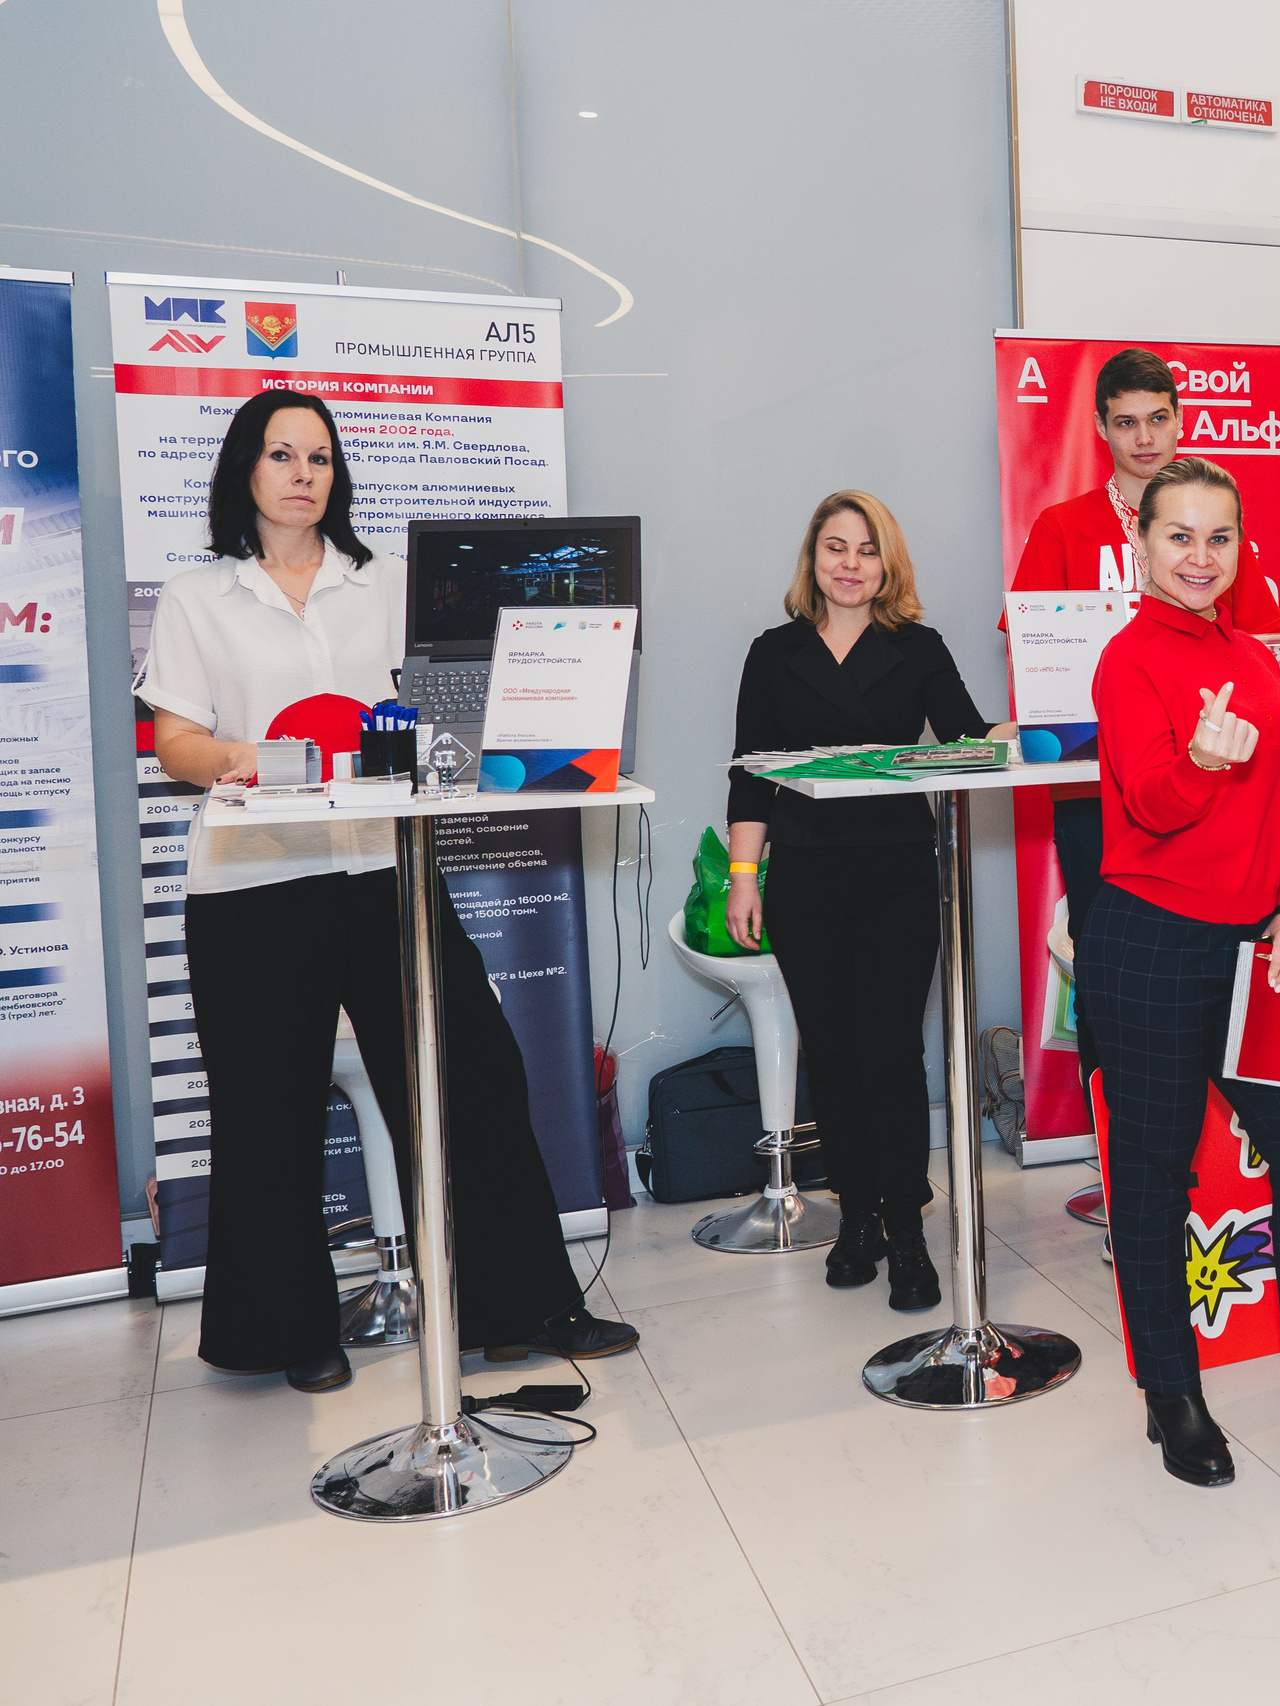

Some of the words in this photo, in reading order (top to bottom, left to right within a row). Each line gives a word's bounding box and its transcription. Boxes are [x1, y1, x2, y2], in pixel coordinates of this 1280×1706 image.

[1100, 83, 1158, 102] ПОРОШОК
[1100, 96, 1116, 108] НЕ
[1118, 98, 1157, 114] ВХОДИ
[1190, 94, 1267, 112] АВТОМАТИКА
[1193, 106, 1265, 124] ОТКЛЮЧЕНА
[485, 321, 536, 344] АЛ5
[335, 341, 475, 361] ПРОМЫШЛЕННАЯ
[480, 349, 537, 364] ГРУППА
[1166, 360, 1250, 393] Свой
[262, 378, 339, 392] ИСТОРИЯ
[342, 381, 434, 396] КОМПАНИИ
[332, 410, 422, 422] люминиевая
[425, 412, 492, 424] Компания
[340, 425, 375, 435] июня
[379, 425, 417, 435] 2002
[420, 428, 455, 437] года,
[159, 436, 177, 444] на
[180, 436, 224, 447] терри
[340, 439, 394, 450] абрики
[398, 440, 419, 449] им.
[422, 441, 450, 450] Я.М.
[453, 440, 530, 453] Свердлова,
[0, 450, 39, 468] ГО
[138, 450, 156, 458] по
[160, 450, 214, 461] адресу
[367, 454, 416, 465] города
[419, 453, 501, 466] Павловский
[504, 456, 549, 467] Посад.
[422, 484, 516, 494] алюминиевых
[139, 494, 209, 505] конструк
[379, 496, 476, 507] строительной
[478, 498, 552, 508] индустрии,
[147, 509, 209, 518] машино
[352, 525, 408, 535] отрасле
[166, 552, 219, 563] Сегодн
[33, 788, 70, 796] отпуску
[147, 804, 179, 814] 2004
[440, 814, 489, 825] заменой
[476, 823, 529, 833] освоение
[0, 836, 41, 844] онкурсу
[0, 846, 46, 854] альности
[152, 844, 185, 854] 2008
[482, 849, 544, 860] процессов,
[440, 862, 506, 874] увеличение
[507, 858, 548, 868] объема
[0, 876, 40, 886] приятия
[154, 884, 183, 894] 2012
[503, 898, 516, 907] до
[518, 894, 552, 905] 16000
[553, 893, 571, 902] м2.
[475, 908, 510, 919] 15000
[511, 908, 538, 916] тонн.
[467, 930, 503, 940] очной
[9, 943, 69, 956] Устинова
[488, 972, 507, 981] №2
[518, 970, 544, 979] Цехе
[546, 966, 567, 976] №2.
[12, 991, 58, 1001] договора
[8, 1010, 36, 1021] (трех)
[187, 1080, 209, 1089] 202
[49, 1093, 69, 1112] д.
[72, 1085, 85, 1106] 3
[189, 1119, 212, 1129] 202
[0, 1119, 86, 1154] -76-54
[10, 1165, 28, 1175] до
[29, 1158, 65, 1172] 17.00
